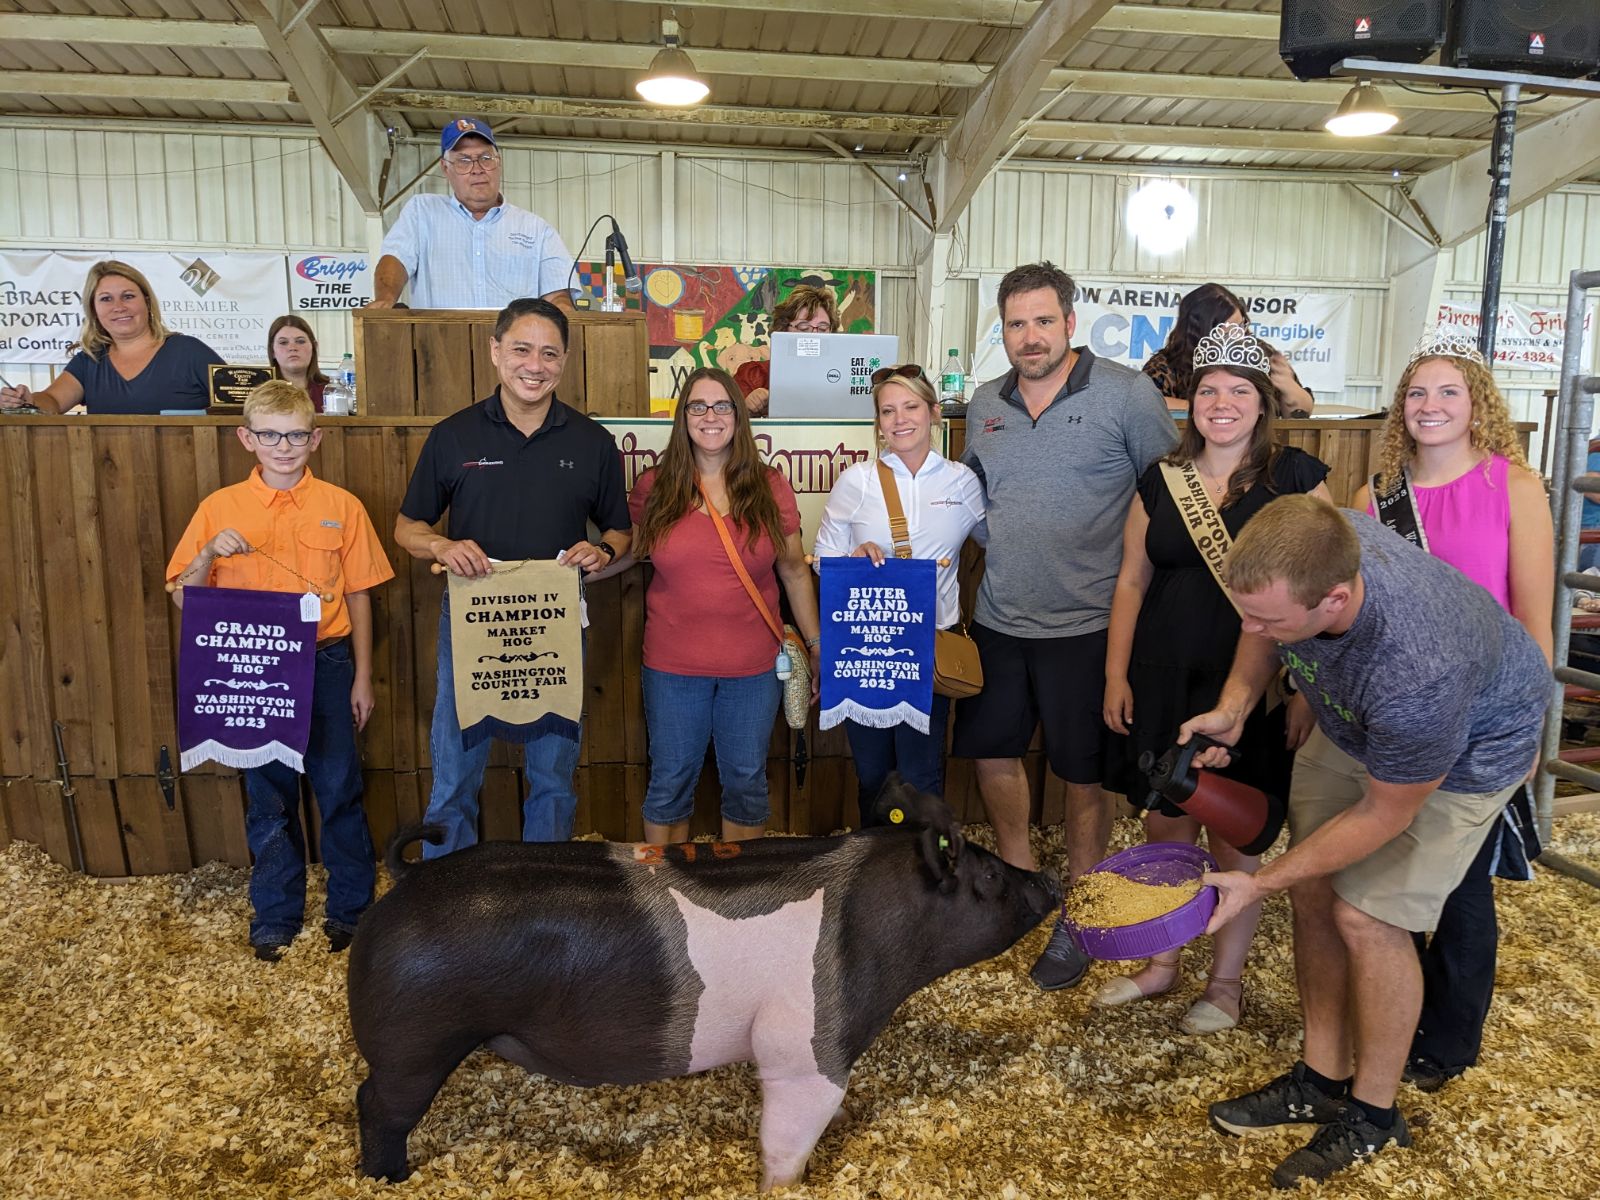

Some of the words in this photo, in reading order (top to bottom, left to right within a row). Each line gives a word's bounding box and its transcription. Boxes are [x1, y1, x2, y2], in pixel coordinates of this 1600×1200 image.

[303, 256, 367, 280] Briggs
[315, 283, 352, 294] TIRE
[299, 297, 370, 308] SERVICE
[1108, 289, 1182, 308] ARENA
[161, 300, 240, 312] PREMIER
[0, 313, 85, 327] RPORATI
[1529, 311, 1592, 335] Frid
[1249, 322, 1325, 341] Tangible
[851, 357, 866, 367] EAT.
[1380, 489, 1407, 509] 2023
[1179, 496, 1202, 530] FAIR
[1181, 462, 1231, 554] WASHINGTON
[471, 594, 537, 606] DIVISION
[543, 593, 559, 602] IV
[849, 587, 906, 600] BUYER
[847, 599, 908, 612] GRAND
[465, 607, 566, 623] CHAMPION
[831, 610, 924, 624] CHAMPION
[214, 621, 286, 638] GRAND
[487, 626, 547, 638] MARKET
[850, 625, 905, 635] MARKET
[195, 634, 303, 653] CHAMPION
[502, 637, 533, 647] HOG
[864, 634, 892, 643] HOG
[217, 653, 280, 666] MARKET
[834, 660, 920, 672] WASHINGTON
[232, 664, 265, 675] HOG
[471, 666, 566, 681] WASHINGTON
[833, 669, 886, 678] COUNTY
[891, 669, 921, 681] FAIR
[471, 678, 529, 691] COUNTY
[535, 676, 568, 687] FAIR
[859, 678, 896, 690] 2023
[195, 694, 296, 708] WASHINGTON
[500, 688, 540, 701] 2023
[194, 705, 256, 715] COUNTY
[261, 706, 296, 719] FAIR
[224, 717, 266, 729] 2023
